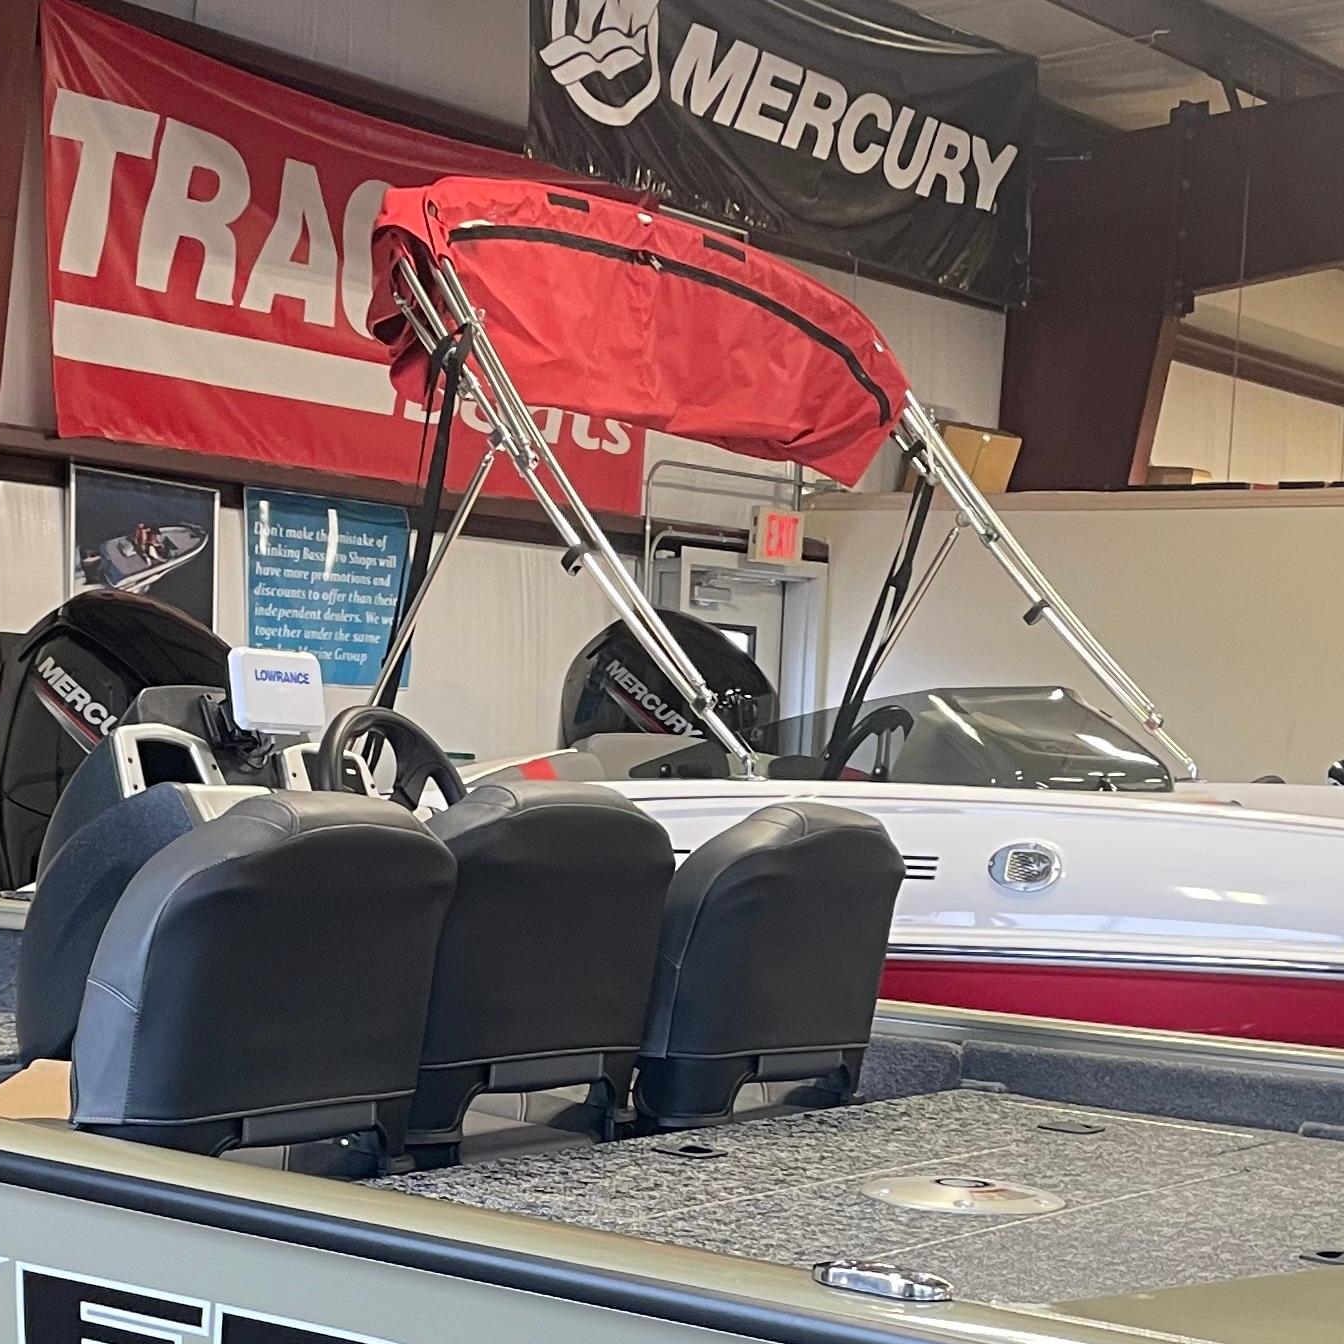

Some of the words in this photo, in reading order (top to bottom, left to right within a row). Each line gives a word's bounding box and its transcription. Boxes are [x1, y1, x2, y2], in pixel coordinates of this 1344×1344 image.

[670, 22, 1018, 212] MERCURY
[254, 520, 285, 539] Don't
[285, 525, 314, 541] make
[337, 532, 374, 548] mistake
[375, 535, 388, 552] of
[766, 511, 800, 558] EXIT
[302, 547, 325, 562] Bass
[348, 551, 378, 569] Shops
[378, 555, 397, 568] will
[255, 561, 282, 577] have
[283, 565, 309, 580] more
[310, 569, 372, 586] promotions
[372, 573, 391, 587] and
[253, 582, 306, 600] discounts
[308, 587, 320, 601] to
[321, 588, 347, 606] offer
[347, 591, 372, 606] than
[254, 604, 322, 622] independent
[323, 608, 363, 624] dealers.
[365, 611, 379, 625] We
[254, 624, 302, 640] together
[303, 627, 332, 642] under
[333, 628, 351, 642] the
[352, 633, 381, 645] same
[334, 648, 368, 666] Group
[255, 669, 310, 685] LOWRANCE
[606, 660, 703, 736] MERCURY
